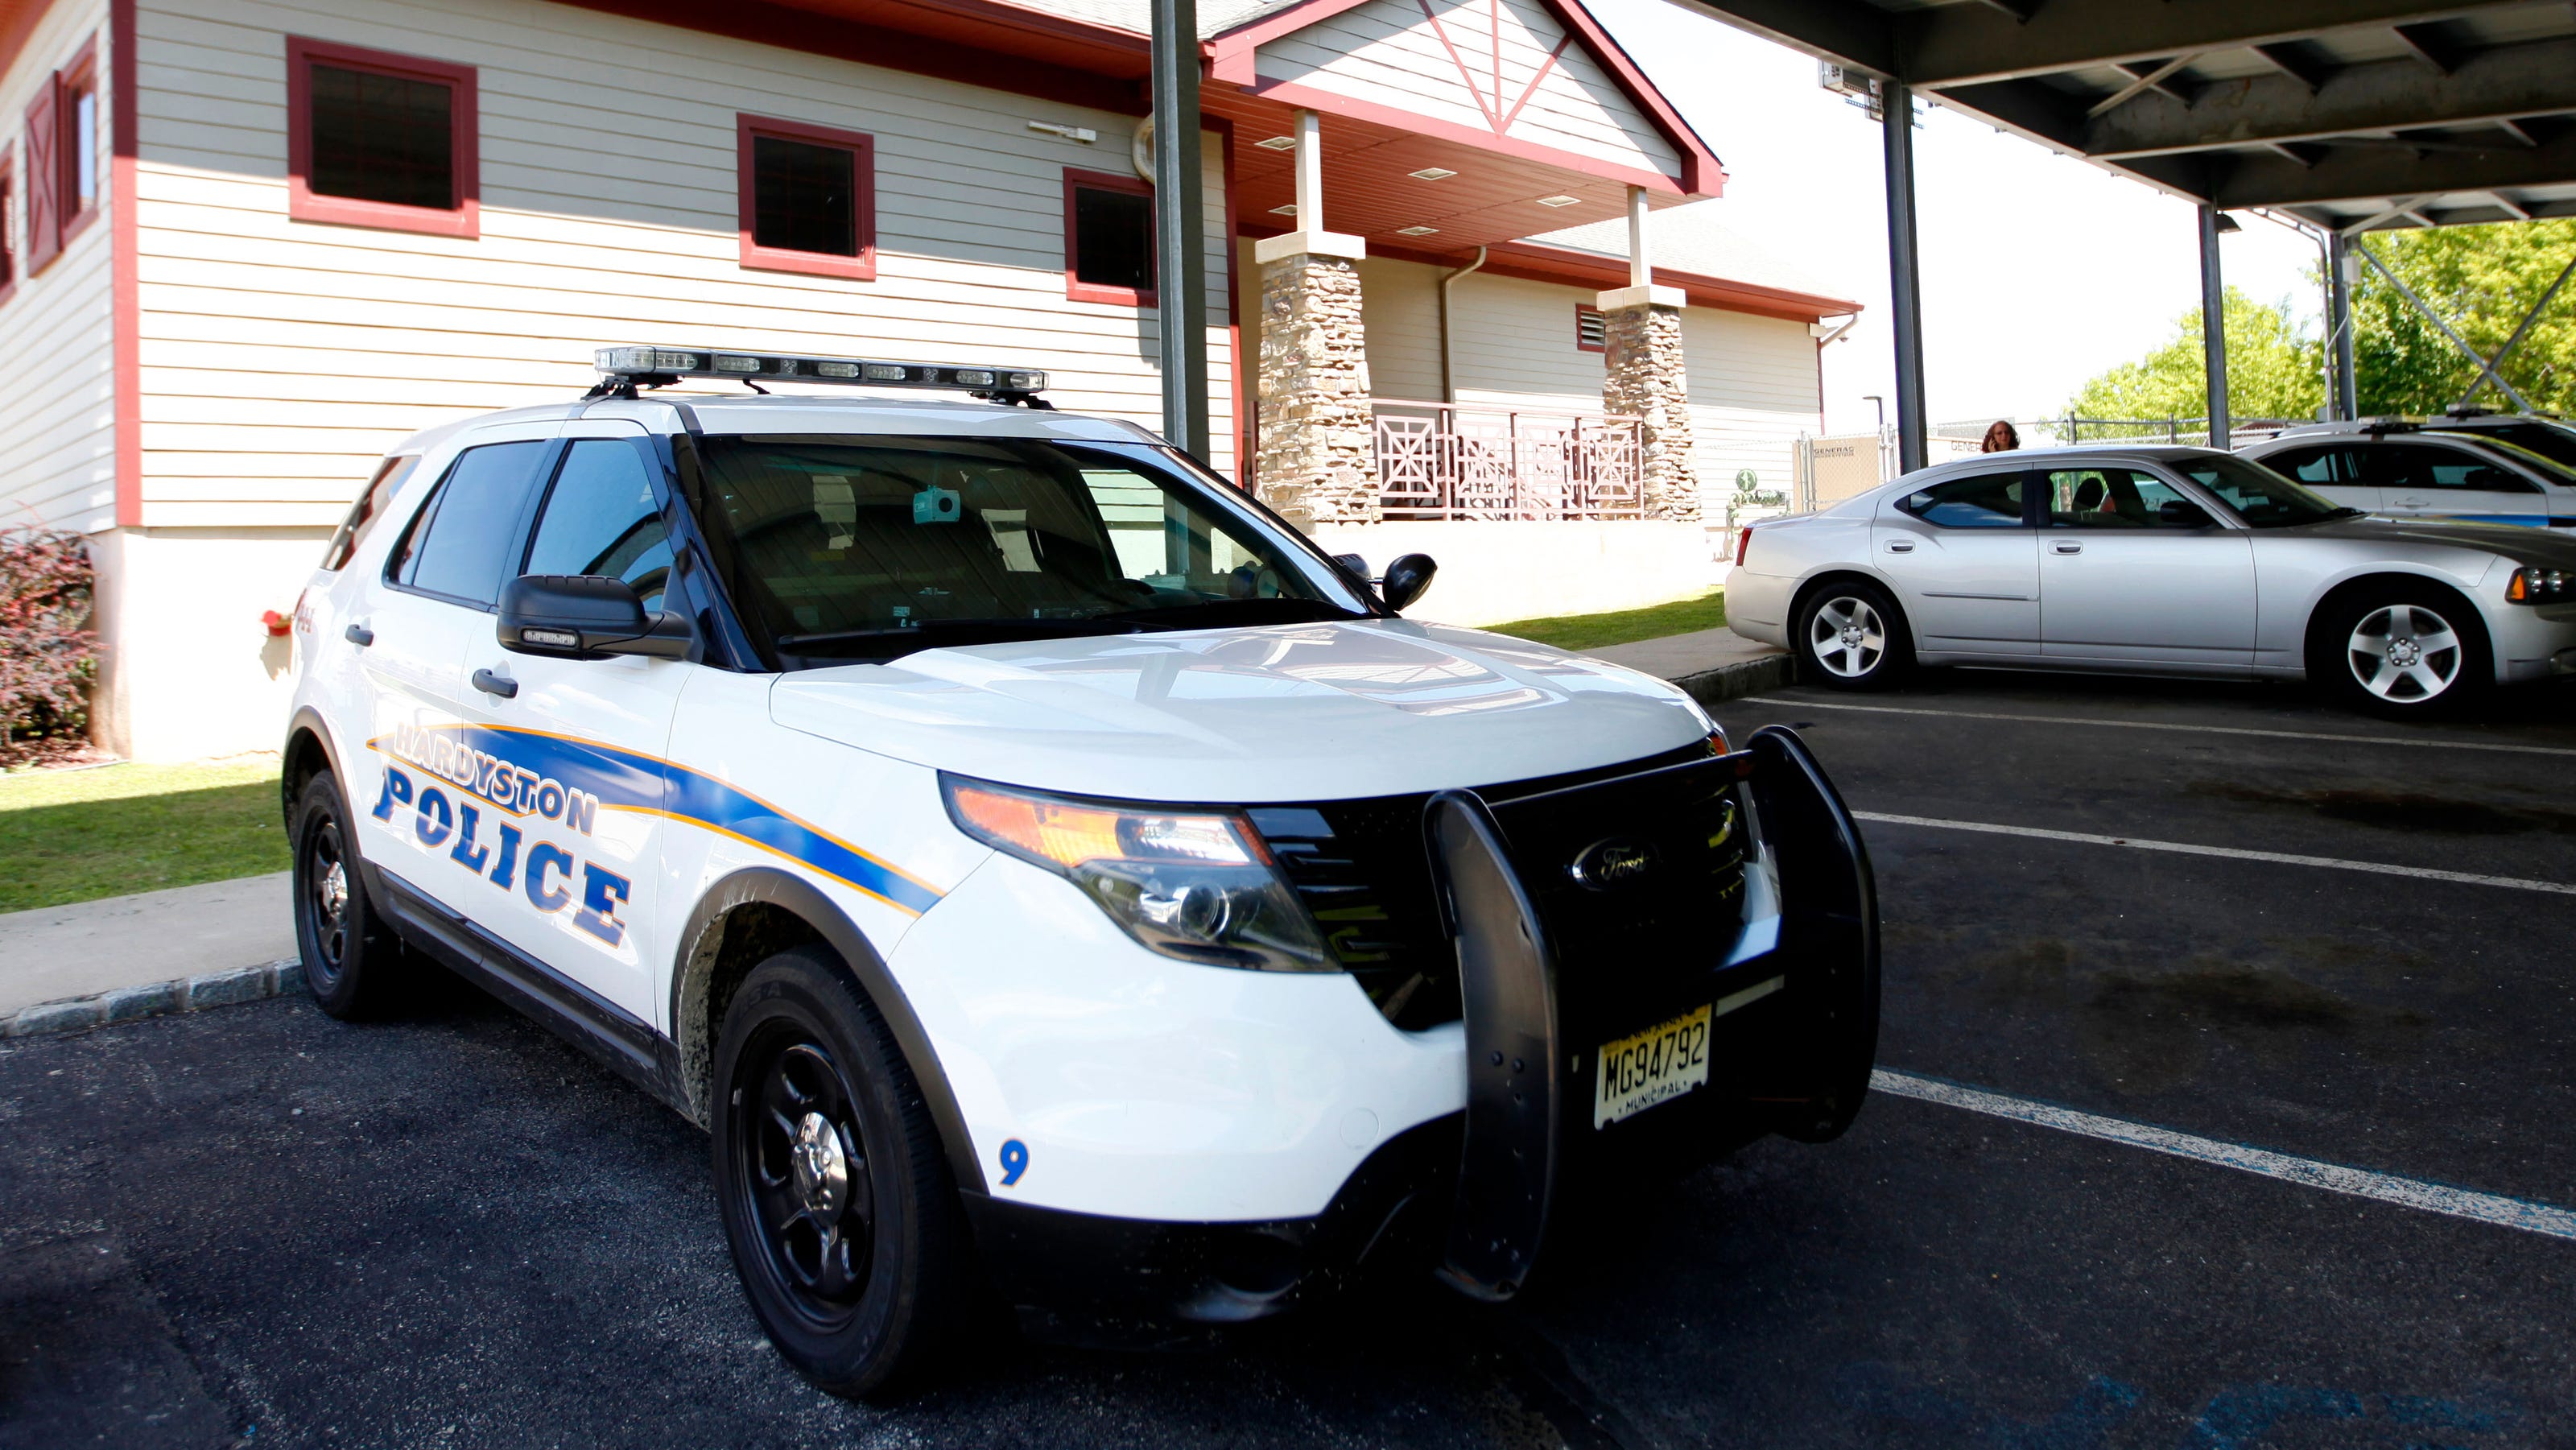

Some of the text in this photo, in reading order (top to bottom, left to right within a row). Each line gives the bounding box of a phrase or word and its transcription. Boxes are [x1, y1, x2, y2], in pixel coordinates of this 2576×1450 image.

[1951, 440, 1983, 452] GENER
[393, 722, 599, 837] HARDYSTON
[372, 762, 631, 948] POLICE
[1600, 845, 1649, 881] Ford
[1604, 1021, 1705, 1103] MG94792
[1625, 1080, 1681, 1113] MUNICIPAL
[999, 1138, 1030, 1188] 9
